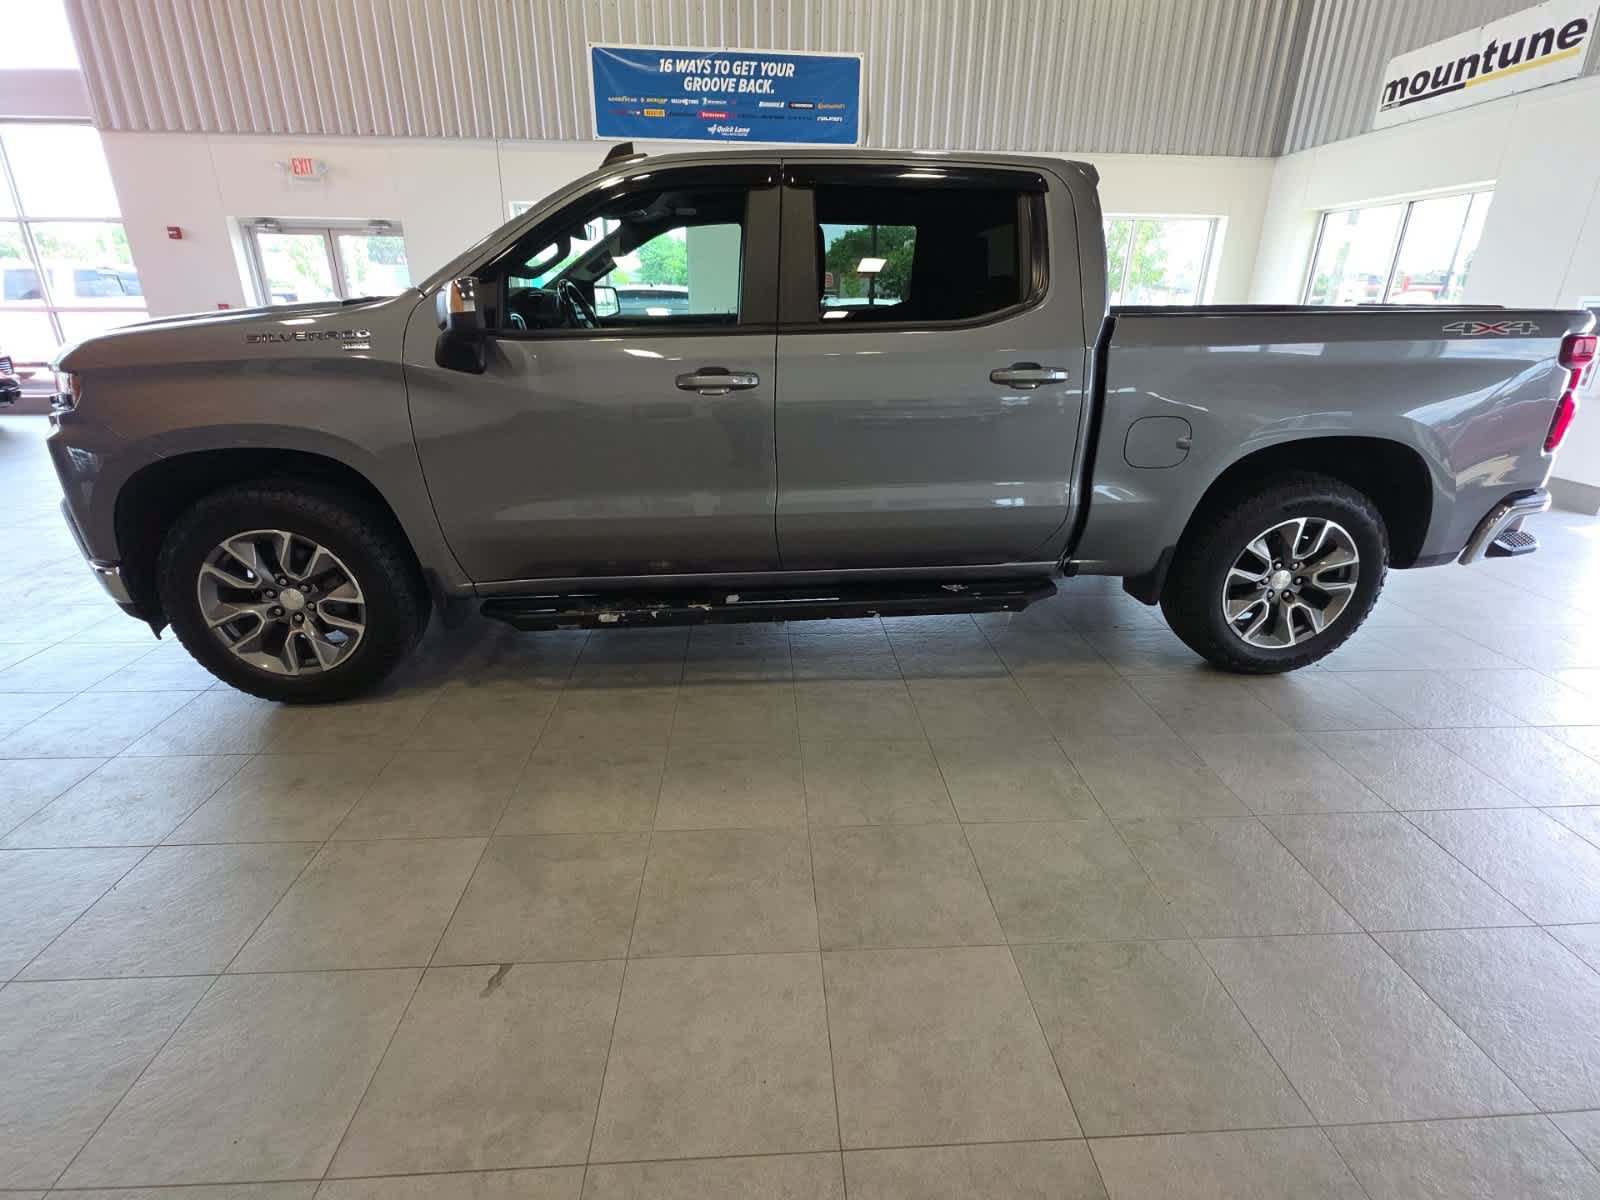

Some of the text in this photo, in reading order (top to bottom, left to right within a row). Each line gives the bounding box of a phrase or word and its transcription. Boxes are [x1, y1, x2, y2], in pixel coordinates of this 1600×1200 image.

[659, 58, 795, 78] 16 WAYS TO GET YOUR
[1381, 18, 1588, 105] mountune
[683, 76, 775, 94] GROOVE BACK.
[291, 157, 313, 176] EXIT
[246, 329, 371, 344] SILVERADO
